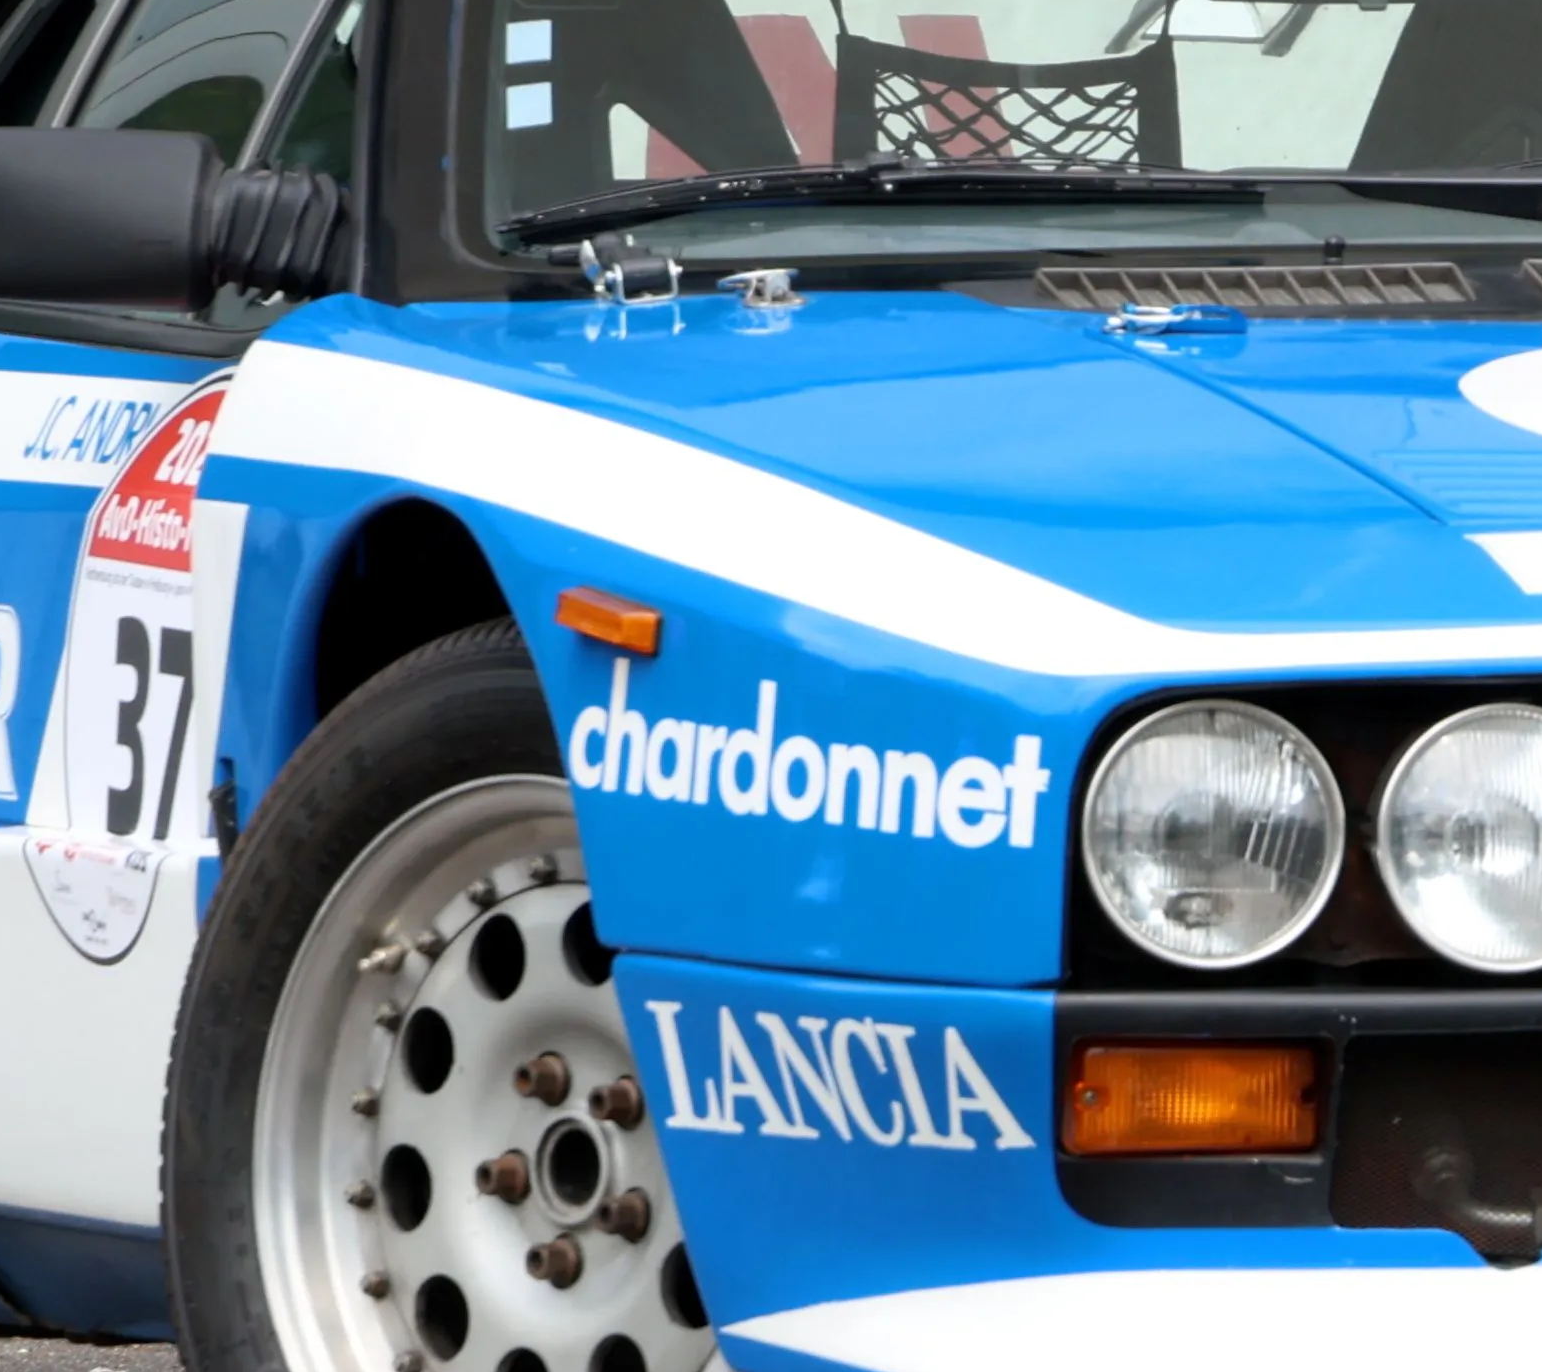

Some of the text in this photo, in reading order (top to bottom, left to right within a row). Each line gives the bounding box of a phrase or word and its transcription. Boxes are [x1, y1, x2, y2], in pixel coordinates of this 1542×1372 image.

[61, 398, 162, 466] ANDR
[106, 615, 195, 842] 37
[569, 657, 1050, 848] chardonnet
[645, 999, 1036, 1150] LANCIA
